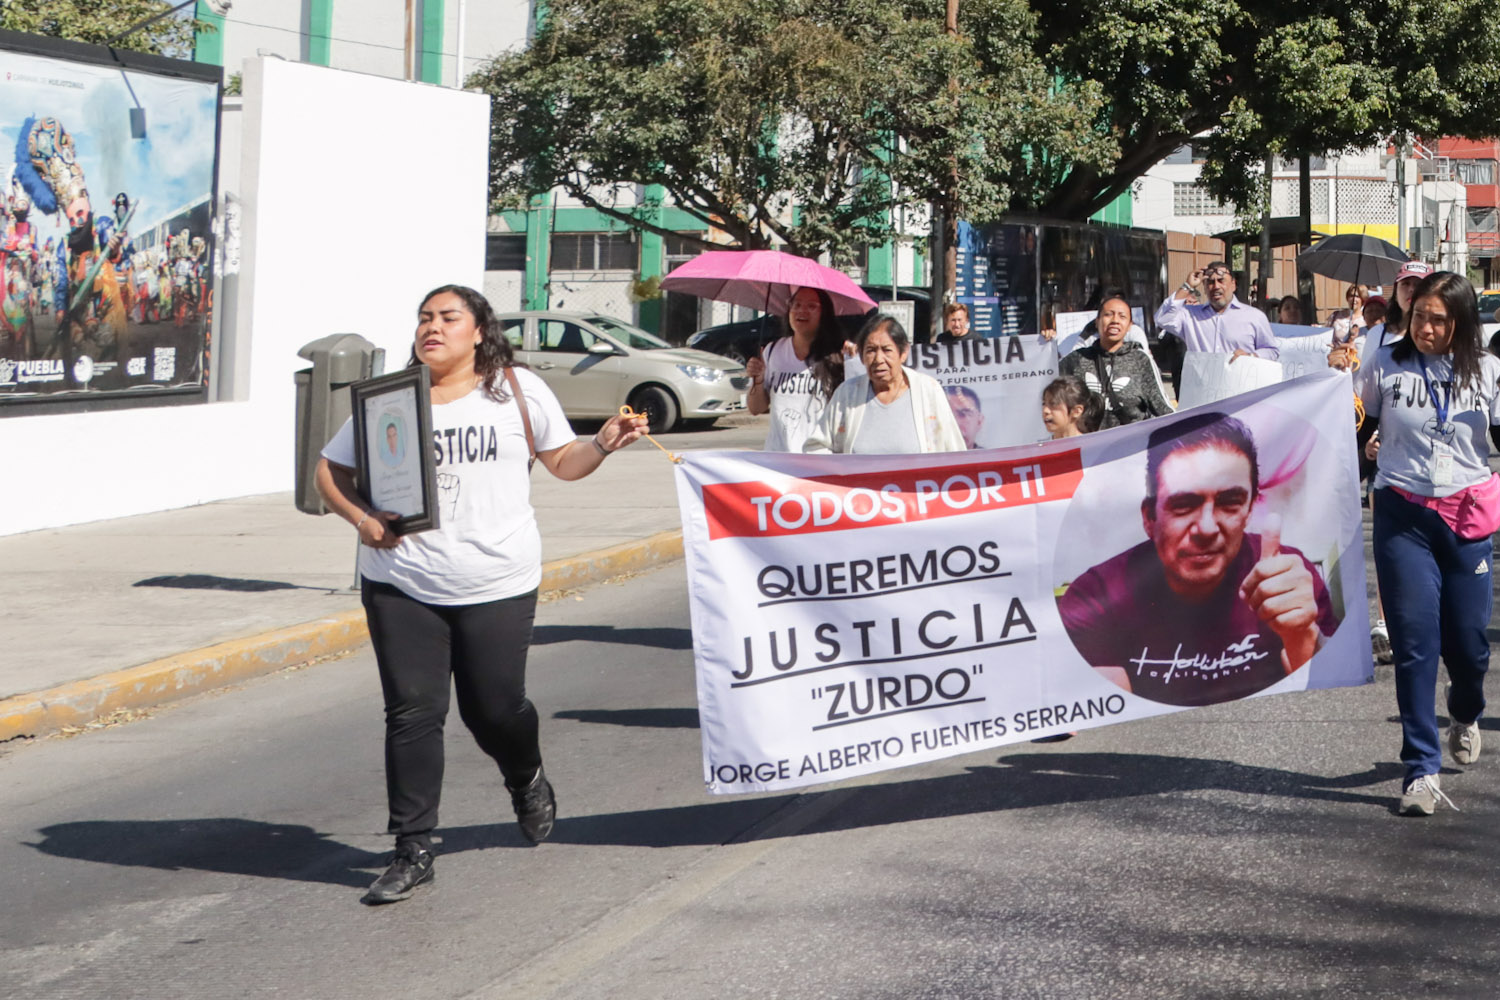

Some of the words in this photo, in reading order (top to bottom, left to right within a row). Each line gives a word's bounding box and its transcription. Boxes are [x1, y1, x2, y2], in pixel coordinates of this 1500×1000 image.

[18, 359, 64, 375] PUEBLA
[905, 335, 1025, 370] USTICIA
[947, 374, 998, 385] FUENTES
[1002, 368, 1054, 381] SERRANO
[433, 425, 498, 467] STICIA
[750, 483, 906, 531] TODOS
[915, 471, 1006, 514] POR
[1013, 464, 1047, 498] TI
[757, 541, 1001, 598] QUEREMOS
[731, 597, 1038, 681] JUSTICIA
[1129, 642, 1270, 684] Hollister
[810, 664, 985, 722] "ZURDO"
[705, 759, 791, 786] JORGE
[799, 737, 904, 778] ALBERTO
[910, 716, 1007, 754] FUENTES
[1013, 694, 1126, 733] SERRANO
